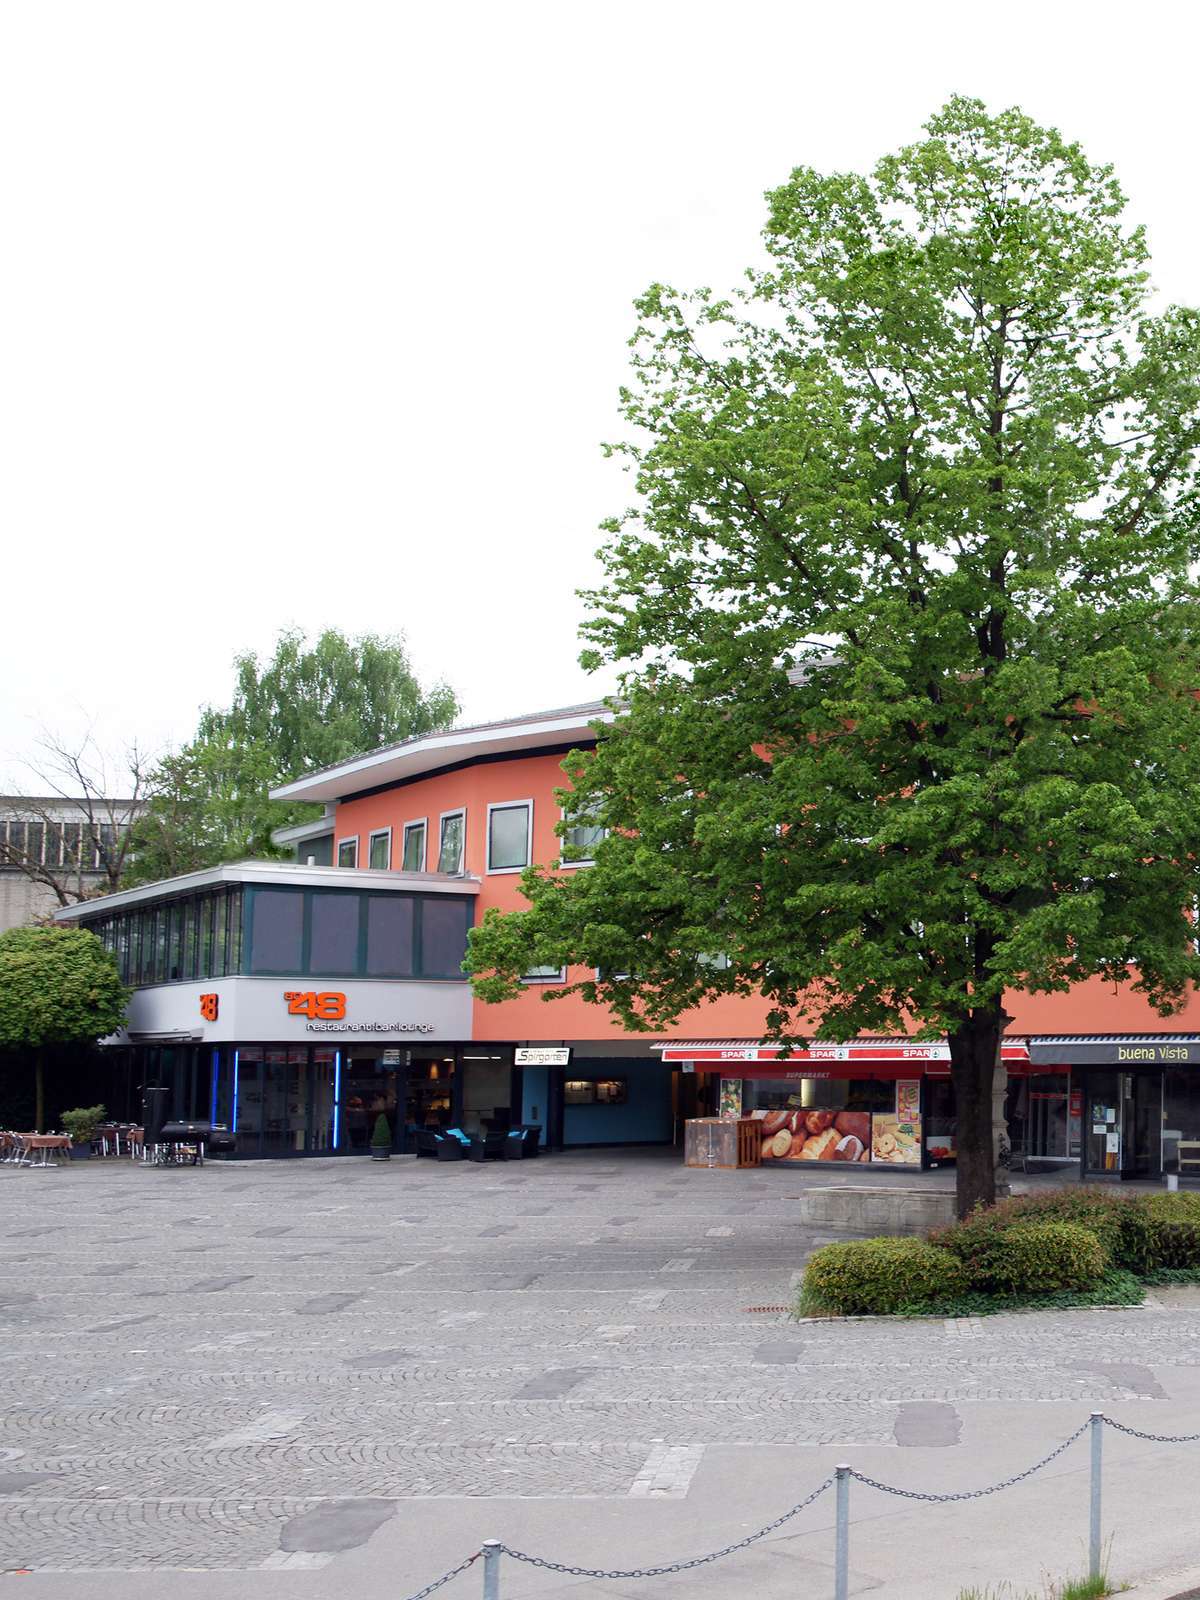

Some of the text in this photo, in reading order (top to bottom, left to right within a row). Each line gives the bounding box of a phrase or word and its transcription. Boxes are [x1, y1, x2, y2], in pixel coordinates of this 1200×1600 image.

[720, 1050, 745, 1058] SPAR
[809, 1050, 835, 1058] SPAR
[902, 1049, 930, 1057] SPAR
[1118, 1046, 1156, 1060] buena
